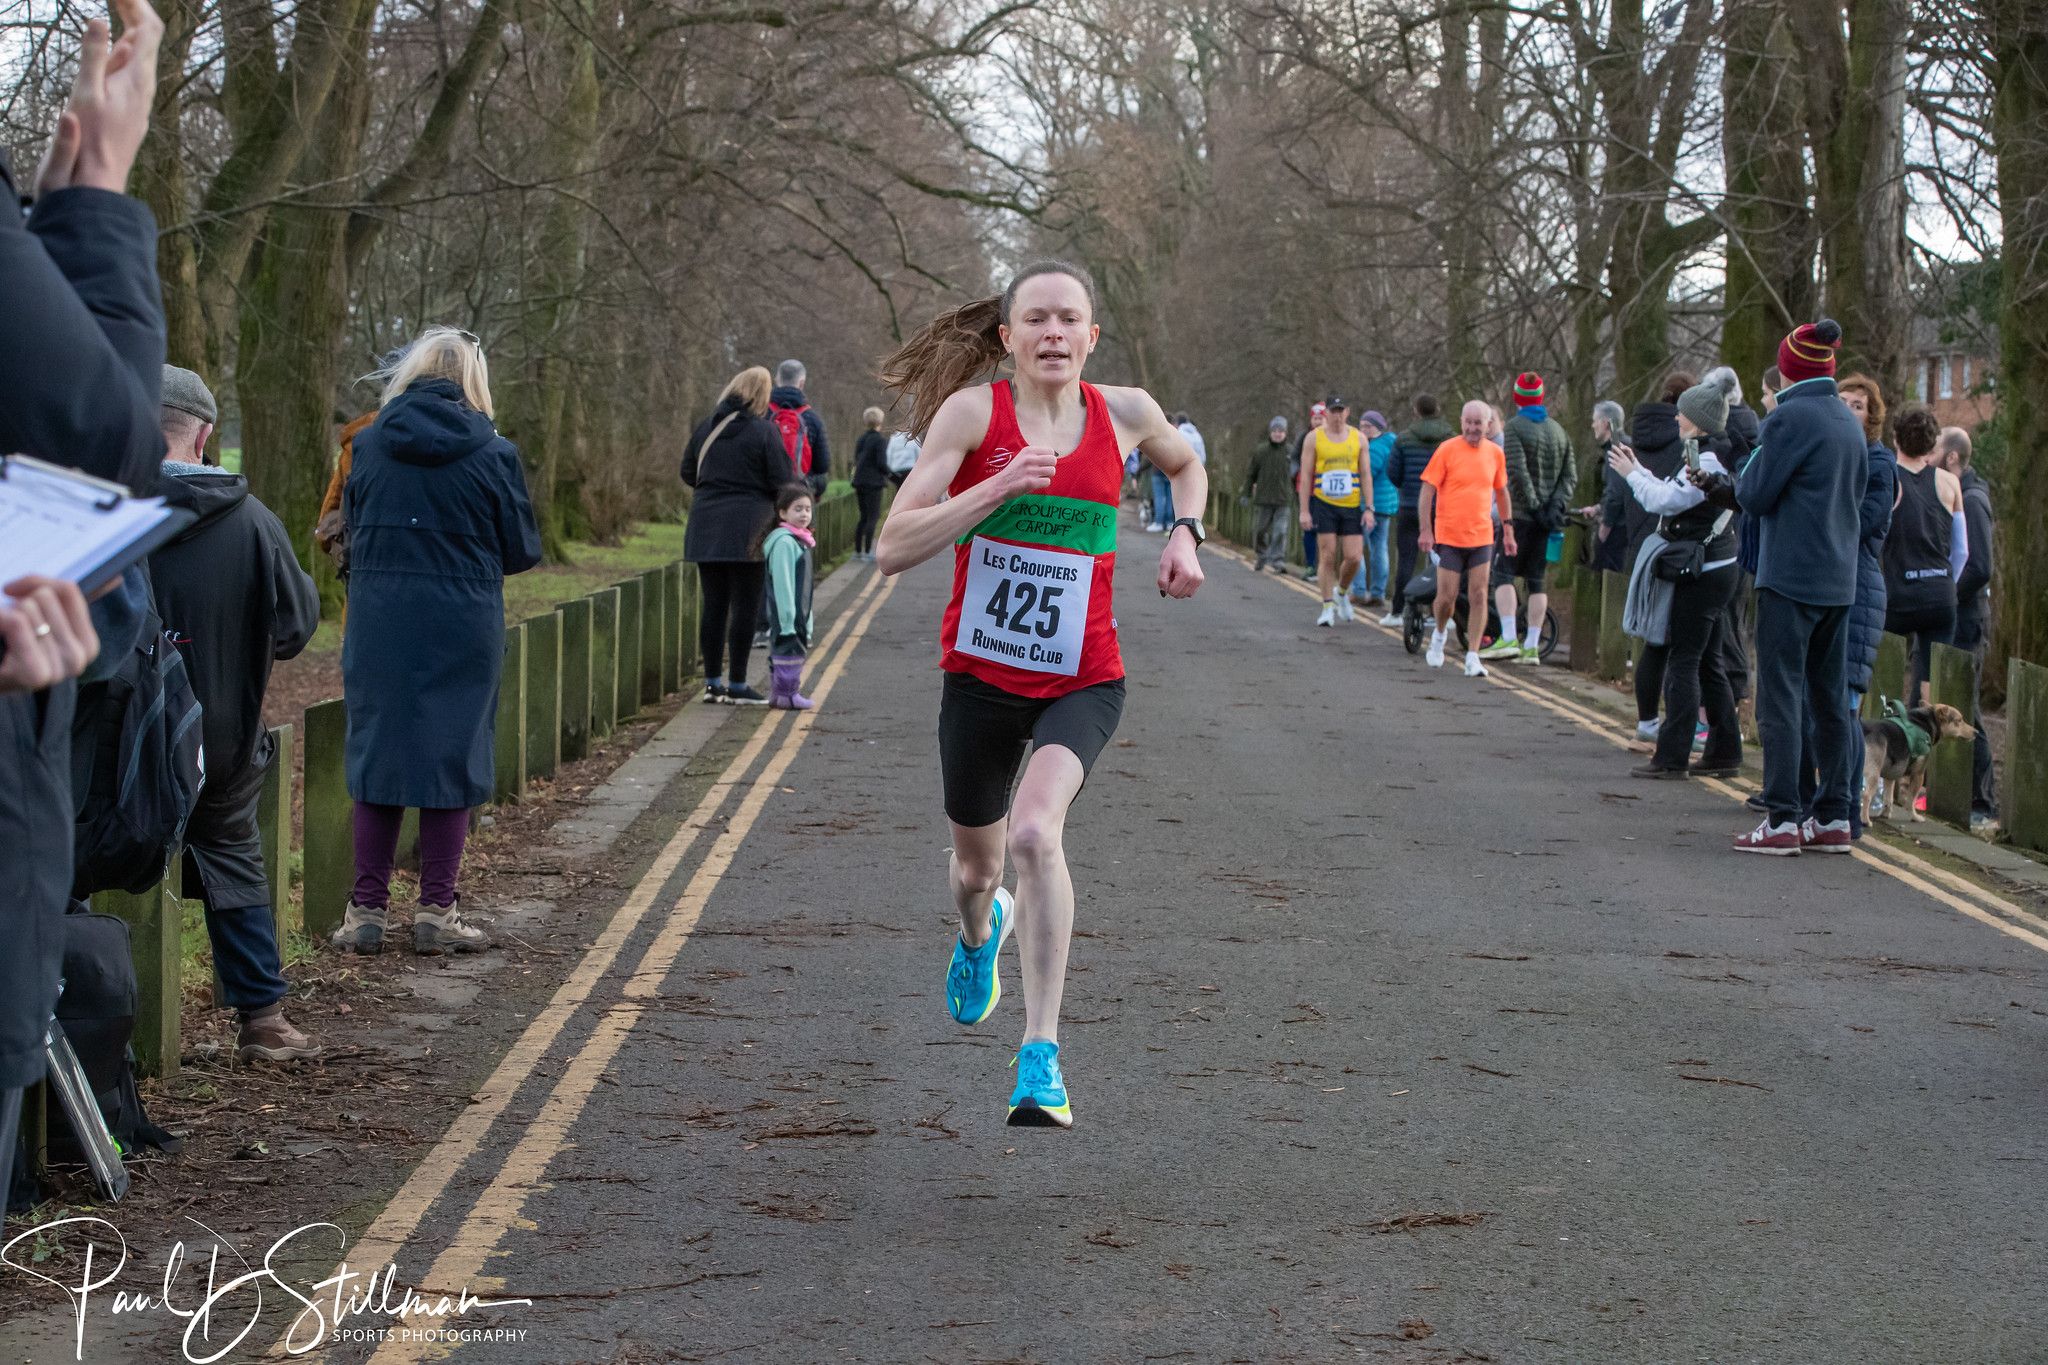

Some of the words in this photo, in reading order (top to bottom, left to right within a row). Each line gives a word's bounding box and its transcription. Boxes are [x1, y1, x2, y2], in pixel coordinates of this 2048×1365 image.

[1329, 478, 1345, 491] 175
[1008, 502, 1089, 524] CROUPIERS
[1091, 512, 1110, 528] RC
[1015, 519, 1072, 537] CARDIFF
[985, 578, 1065, 639] 425
